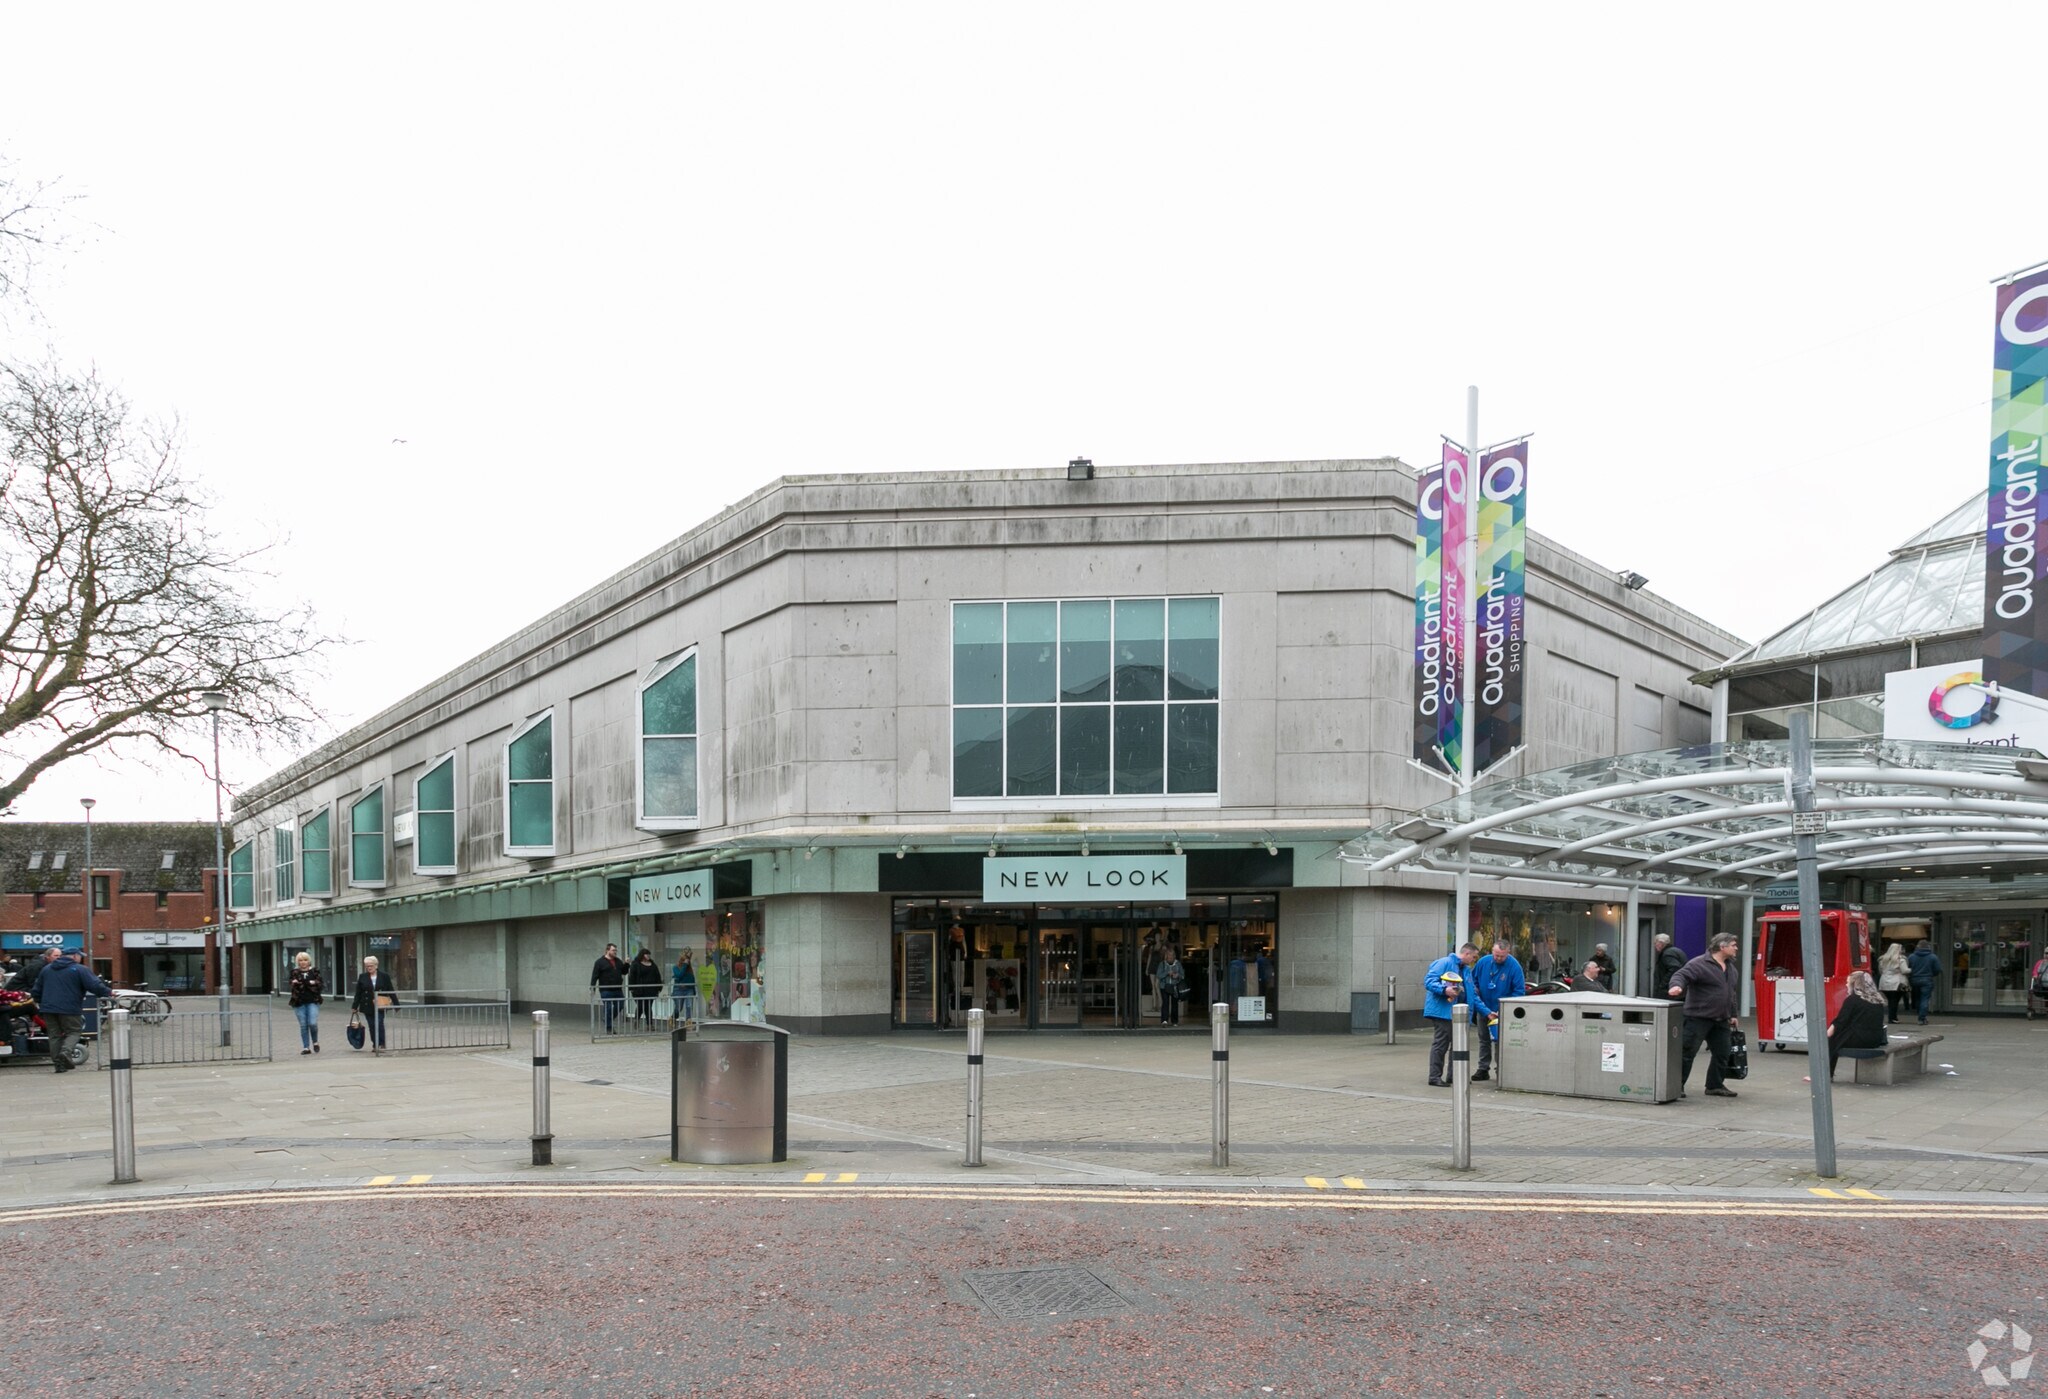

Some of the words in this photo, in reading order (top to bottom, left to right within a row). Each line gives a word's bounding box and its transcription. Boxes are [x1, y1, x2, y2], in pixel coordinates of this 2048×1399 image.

[1481, 456, 1525, 502] Q
[1992, 439, 2039, 619] Quadrant
[1417, 587, 1441, 716] Quadrant
[1443, 571, 1458, 705] Quadrant
[1479, 571, 1506, 706] Quadrant
[1510, 595, 1521, 673] SHOPPING
[635, 887, 661, 903] NEW
[666, 883, 701, 901] LOOK
[1000, 870, 1069, 888] NEW
[1087, 869, 1169, 887] LOOK
[23, 934, 64, 945] ROCO
[1779, 1015, 1792, 1025] Best
